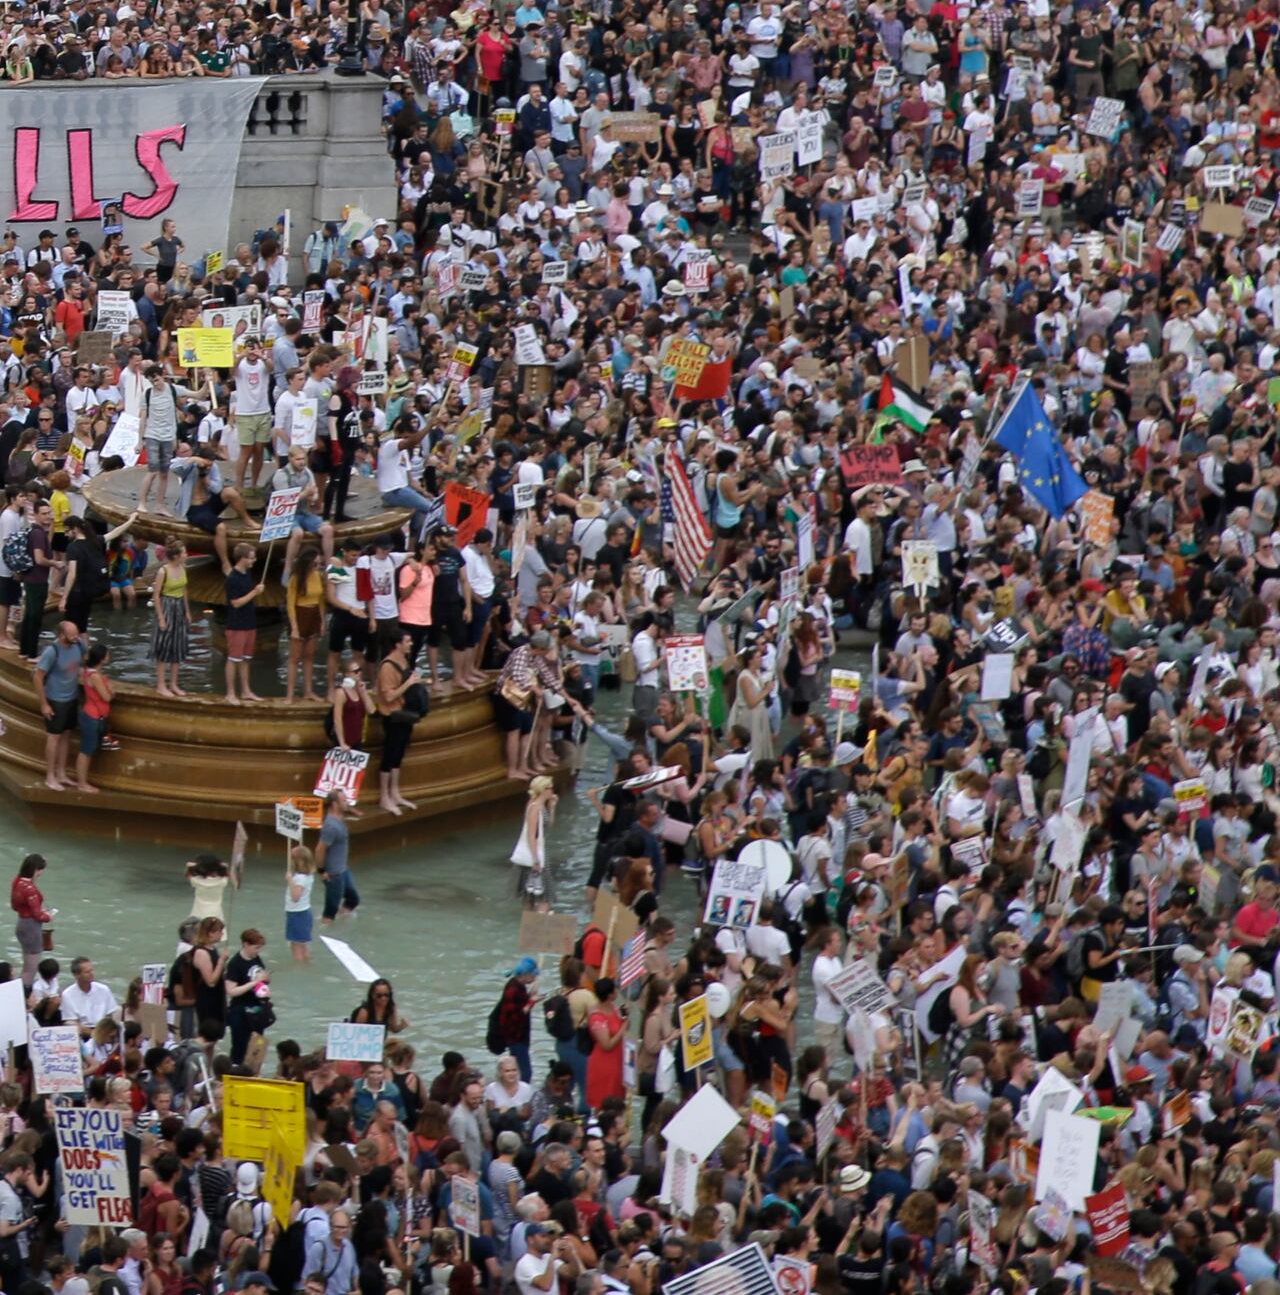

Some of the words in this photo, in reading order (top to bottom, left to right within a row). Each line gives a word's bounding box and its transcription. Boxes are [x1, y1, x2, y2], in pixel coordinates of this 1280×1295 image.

[686, 262, 708, 280] NOT
[664, 355, 702, 373] BELONG
[359, 381, 385, 390] TRUMP
[677, 371, 700, 387] HERE
[840, 446, 894, 468] TRUMP
[270, 493, 300, 507] TRUMP
[268, 502, 300, 518] NOT
[325, 747, 367, 767] TRUMP
[322, 759, 361, 788] NOT
[278, 818, 300, 832] TRUMP
[32, 1029, 52, 1042] God
[329, 1024, 382, 1041] DUMP
[328, 1042, 382, 1057] TRUMP
[55, 1110, 78, 1129] IF
[78, 1111, 120, 1133] YOU
[61, 1130, 90, 1148] LIE
[94, 1134, 126, 1152] WITH
[62, 1148, 102, 1170] DOGS
[65, 1171, 116, 1193] YOU'LL
[68, 1190, 97, 1209] GET
